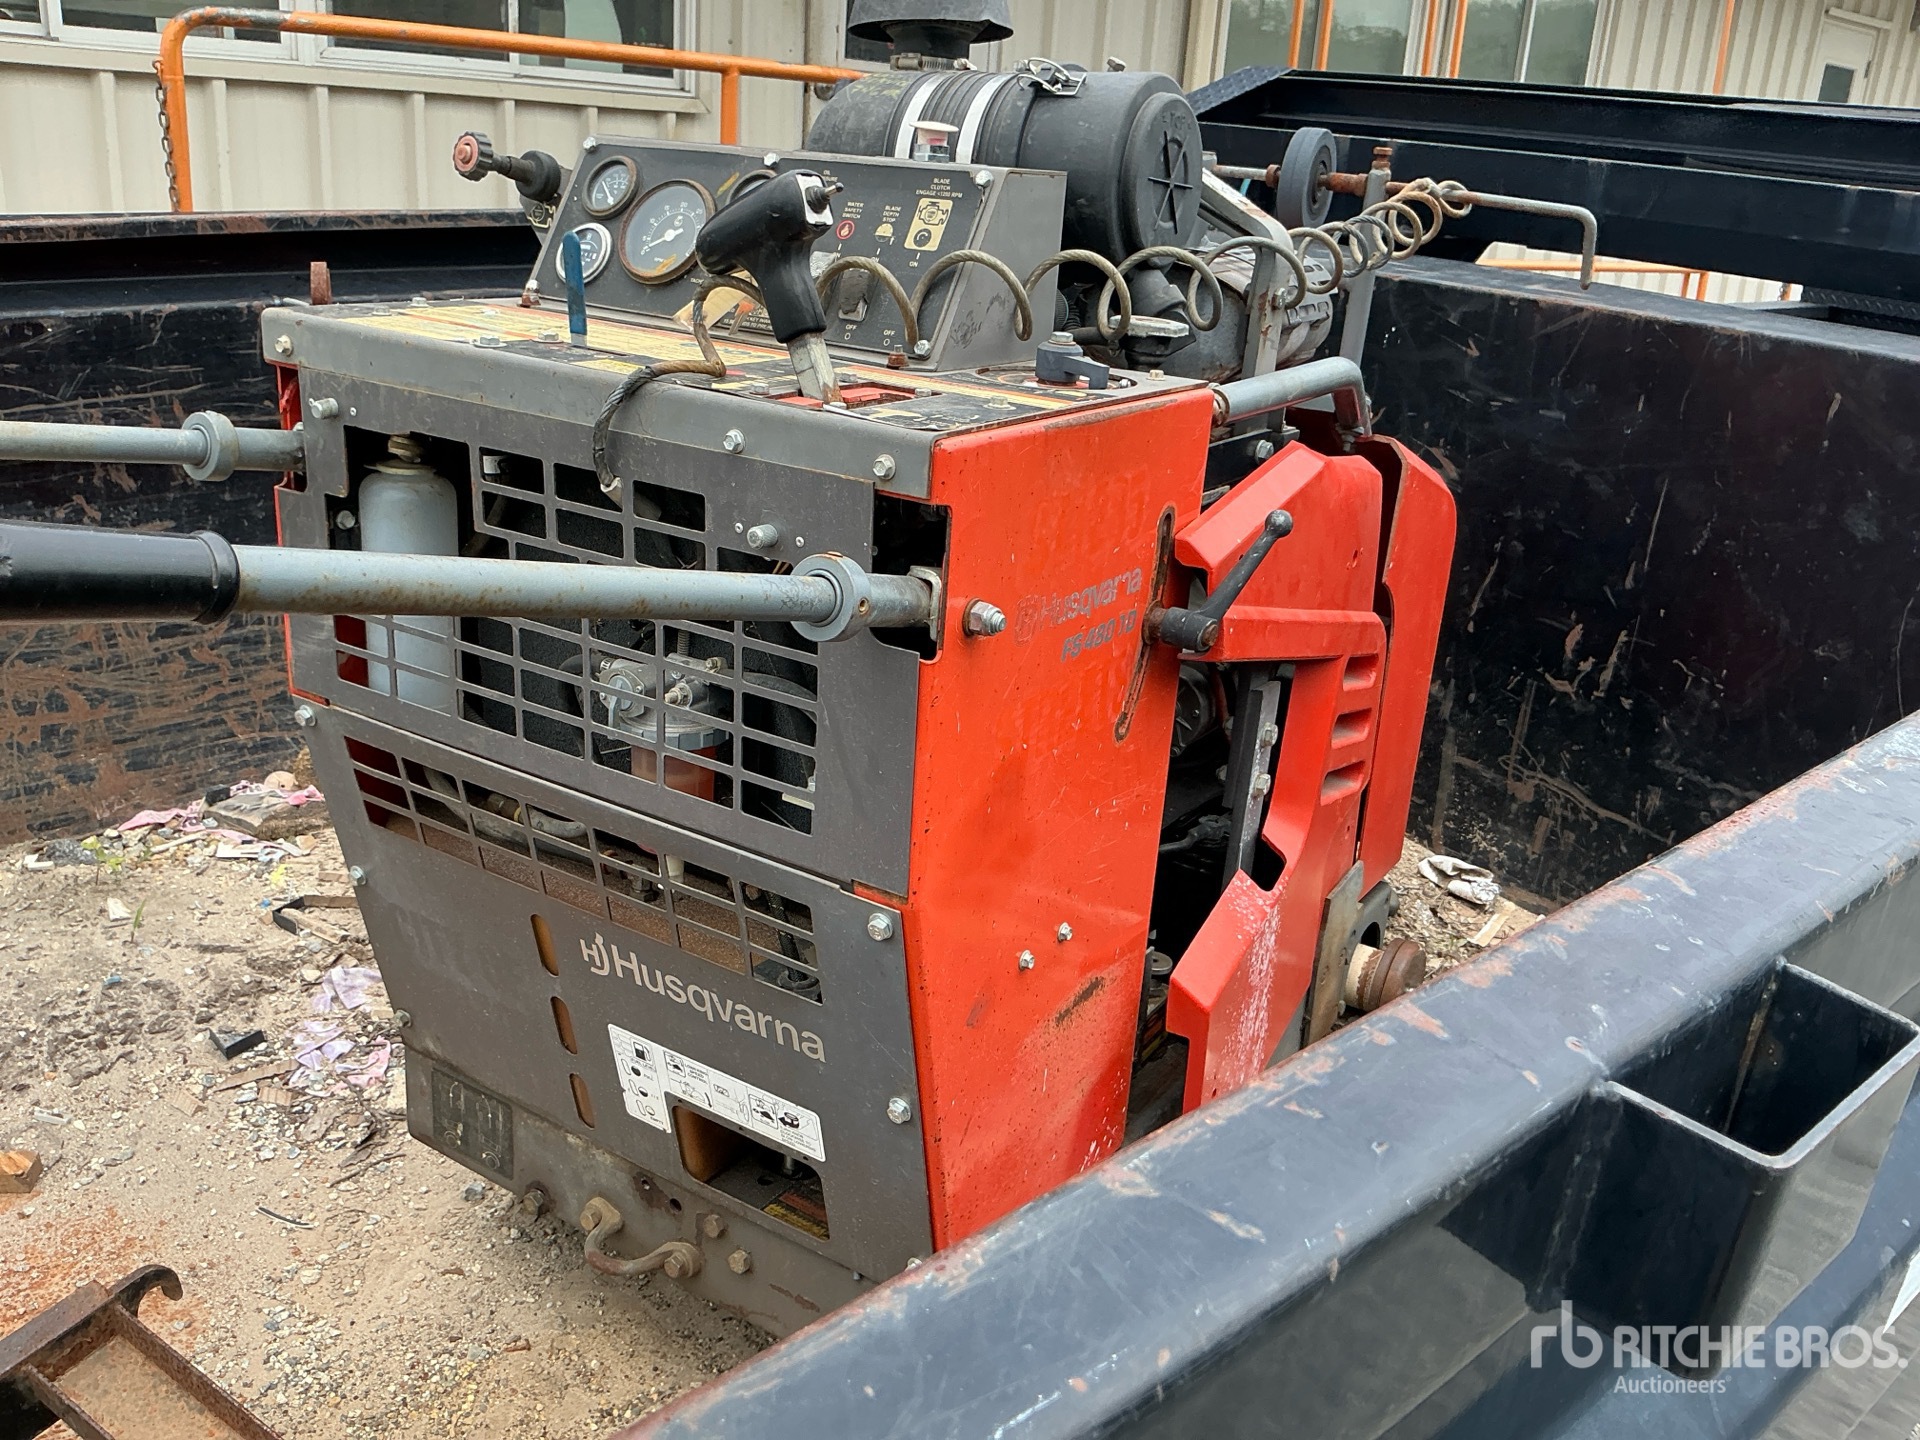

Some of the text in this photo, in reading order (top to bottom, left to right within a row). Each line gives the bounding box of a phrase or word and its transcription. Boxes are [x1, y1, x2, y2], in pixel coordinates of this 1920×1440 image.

[933, 177, 951, 185] BLADE
[909, 260, 919, 268] ON
[883, 329, 896, 337] OFF
[1041, 567, 1142, 631] Husqvarna
[1060, 632, 1084, 664] FS
[611, 942, 827, 1064] Husqvarna
